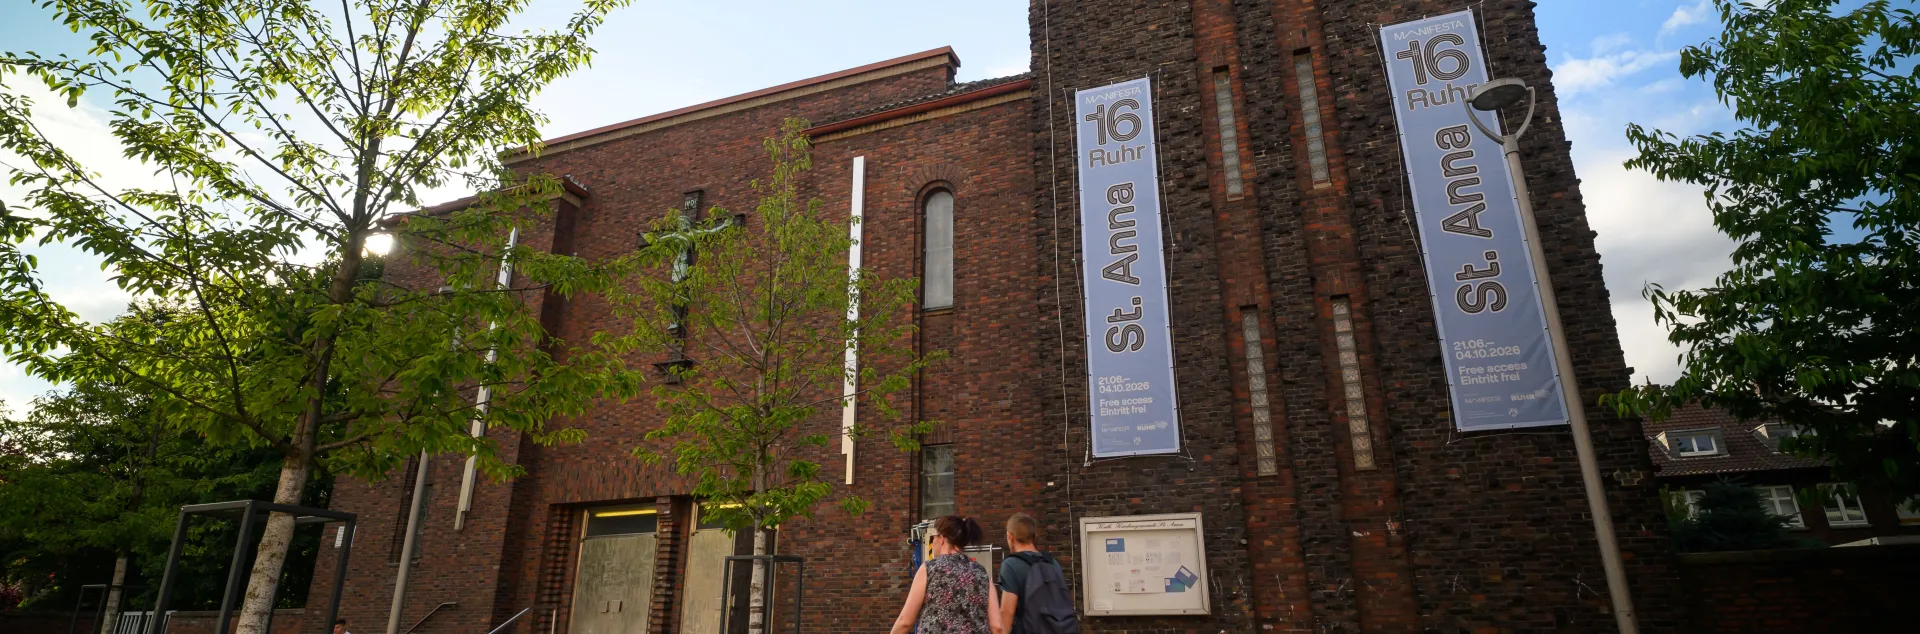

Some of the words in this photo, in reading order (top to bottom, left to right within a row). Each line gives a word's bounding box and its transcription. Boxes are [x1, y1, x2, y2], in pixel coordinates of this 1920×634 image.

[1393, 20, 1464, 41] MANIFESTA
[1396, 33, 1470, 85] 16
[1085, 87, 1141, 104] MANIFESTA
[1406, 83, 1478, 111] Ruhr
[1085, 98, 1142, 146] 16
[1088, 144, 1146, 169] Ruhr
[1434, 124, 1494, 239] Anna
[1101, 181, 1140, 286] Anna
[1455, 250, 1508, 314] St.
[1105, 296, 1145, 354] St.
[1455, 345, 1521, 360] 04.10.2026
[1458, 365, 1485, 375] Free
[1487, 362, 1528, 372] access
[1461, 374, 1499, 386] Eintritt
[1501, 371, 1521, 381] frei
[1099, 381, 1150, 394] 04.10.2026
[1100, 398, 1120, 407] Free
[1121, 396, 1154, 406] access
[1100, 406, 1130, 417] Eintritt
[1131, 405, 1147, 414] frei
